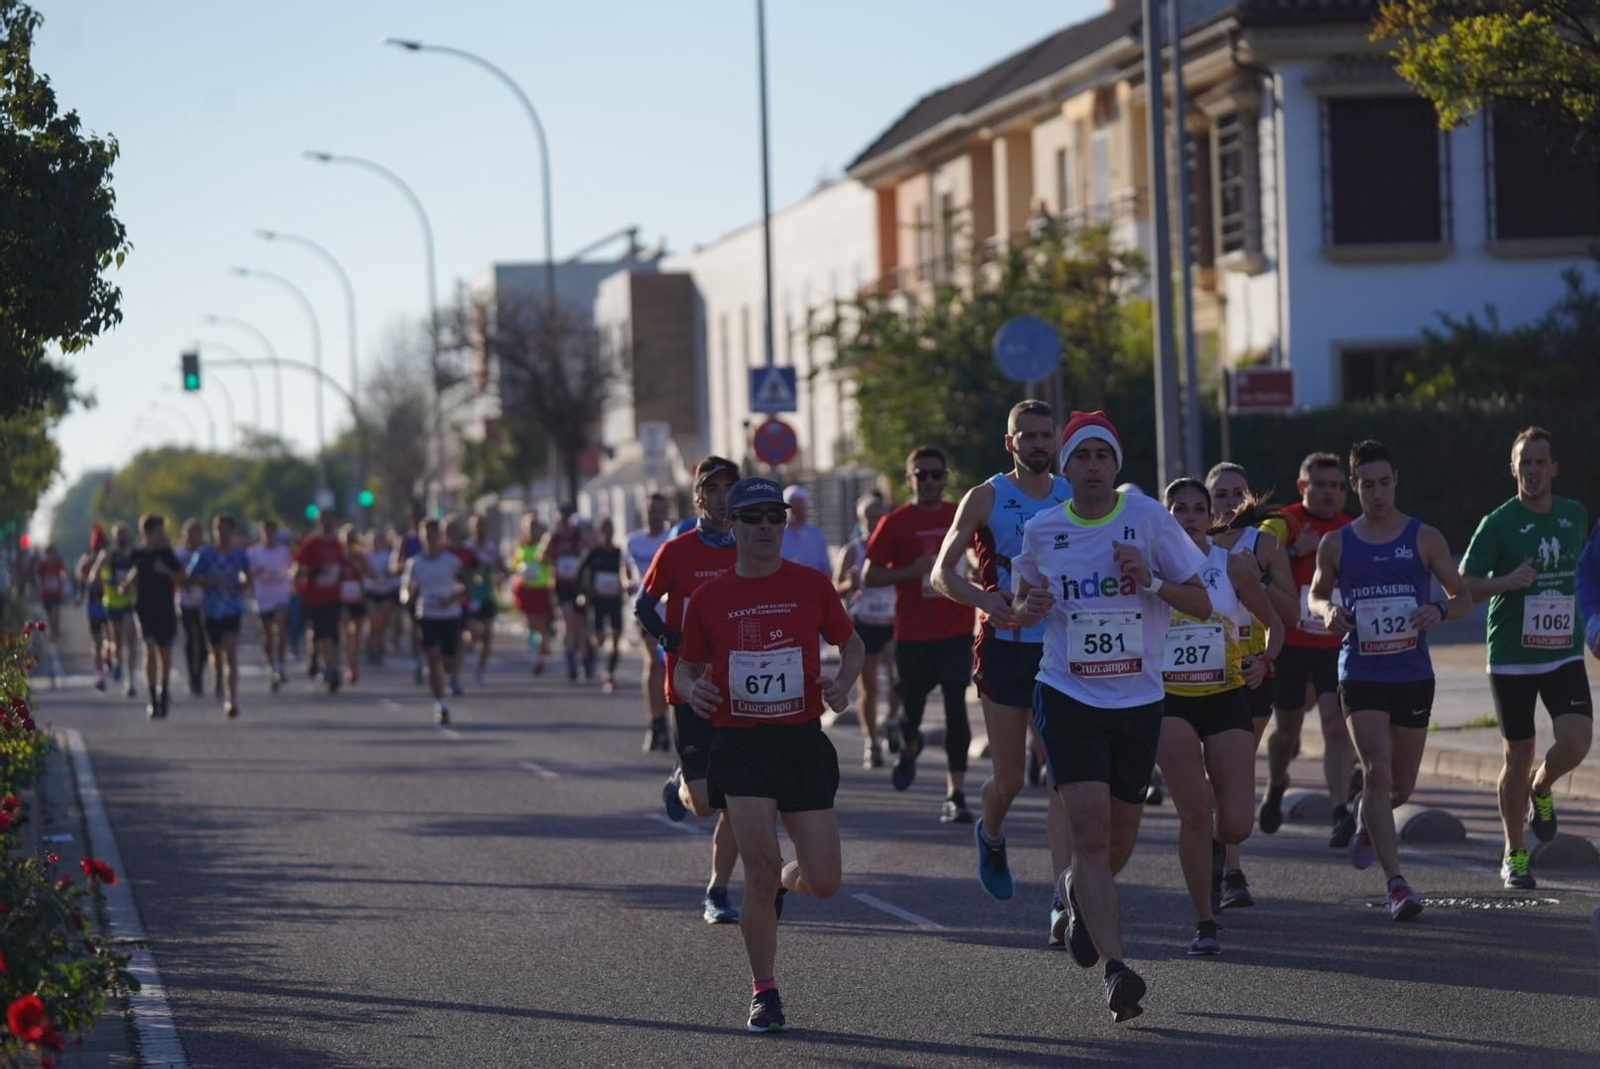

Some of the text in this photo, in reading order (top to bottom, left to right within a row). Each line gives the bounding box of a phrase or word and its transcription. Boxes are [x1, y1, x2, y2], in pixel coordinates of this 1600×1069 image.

[746, 482, 776, 492] adidas
[1124, 526, 1135, 540] in
[1061, 571, 1137, 601] indea
[1351, 583, 1418, 599] TROTASIERRA
[1371, 615, 1406, 635] 132
[1532, 613, 1570, 631] 1062
[769, 628, 783, 641] 50
[1084, 632, 1125, 655] 581
[1173, 645, 1211, 666] 287
[1075, 661, 1130, 674] Cruzcampo
[745, 672, 786, 694] 671
[1164, 671, 1213, 682] Cruzcampo
[738, 700, 792, 714] Cruzcampo
